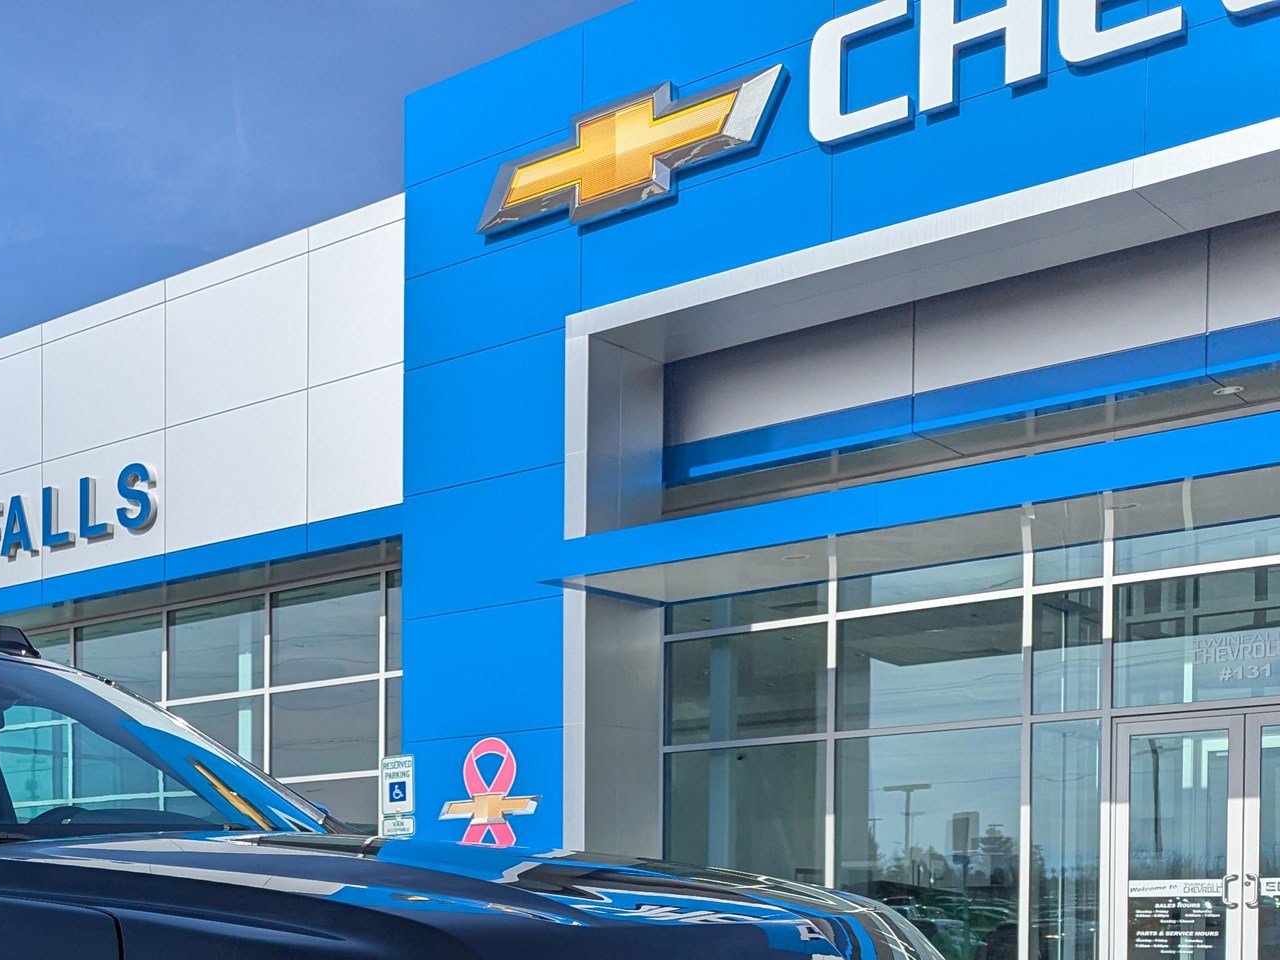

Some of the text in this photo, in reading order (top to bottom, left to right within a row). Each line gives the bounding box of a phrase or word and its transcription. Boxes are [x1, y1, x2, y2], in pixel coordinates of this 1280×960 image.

[1193, 643, 1280, 665] CHEVROL
[383, 761, 411, 770] RESERVED
[384, 771, 410, 780] PARKING
